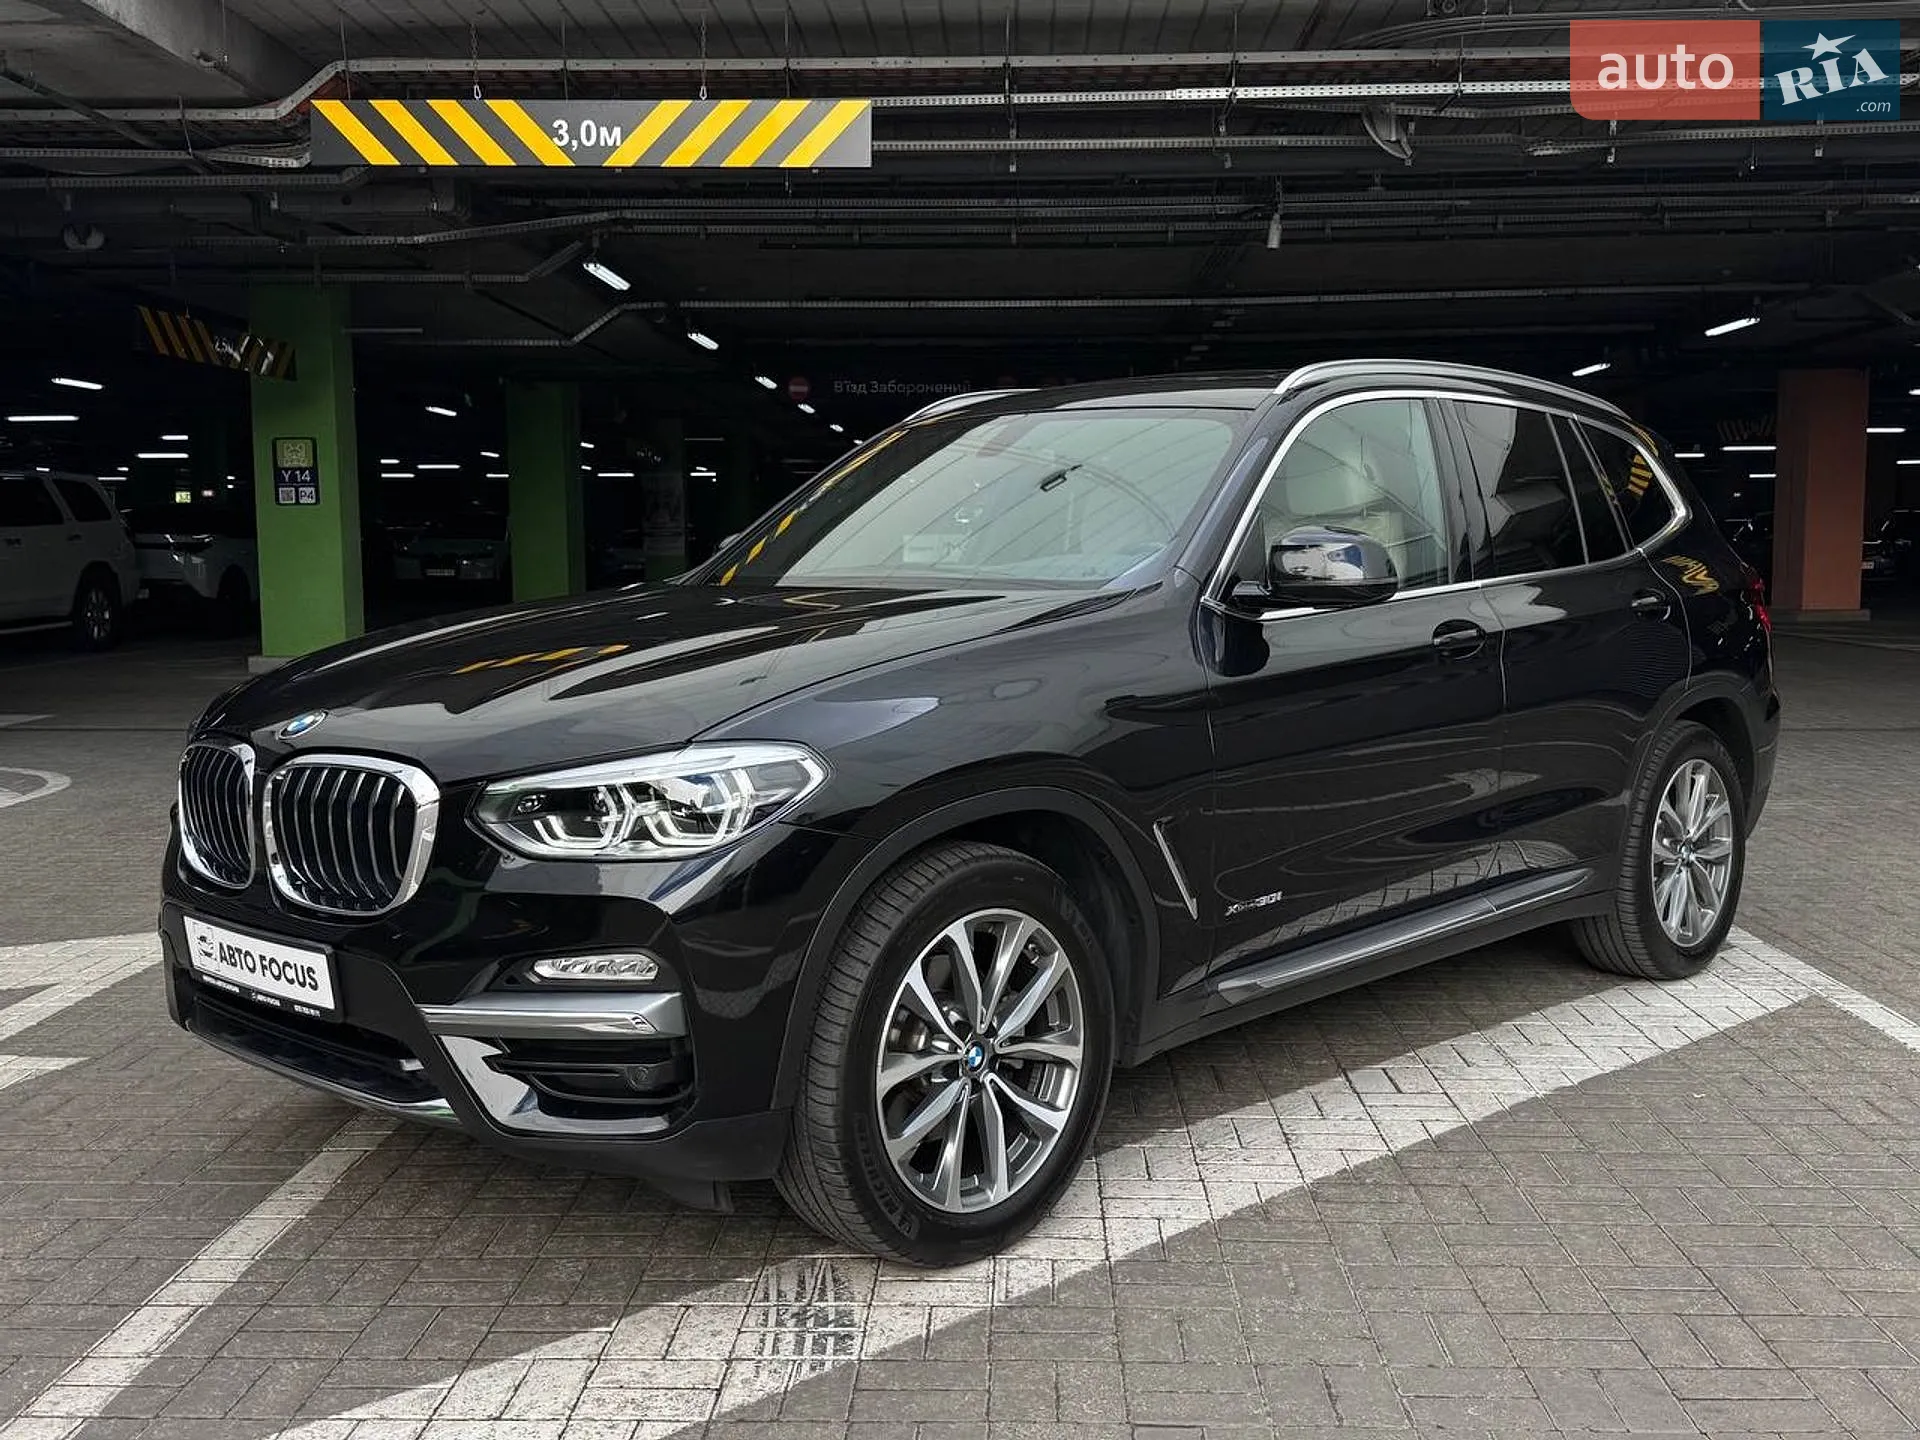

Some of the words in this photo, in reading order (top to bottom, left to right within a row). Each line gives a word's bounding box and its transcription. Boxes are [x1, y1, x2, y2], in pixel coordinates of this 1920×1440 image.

[552, 119, 621, 152] 3,0м
[295, 469, 311, 482] 14
[258, 954, 318, 991] FOCUS
